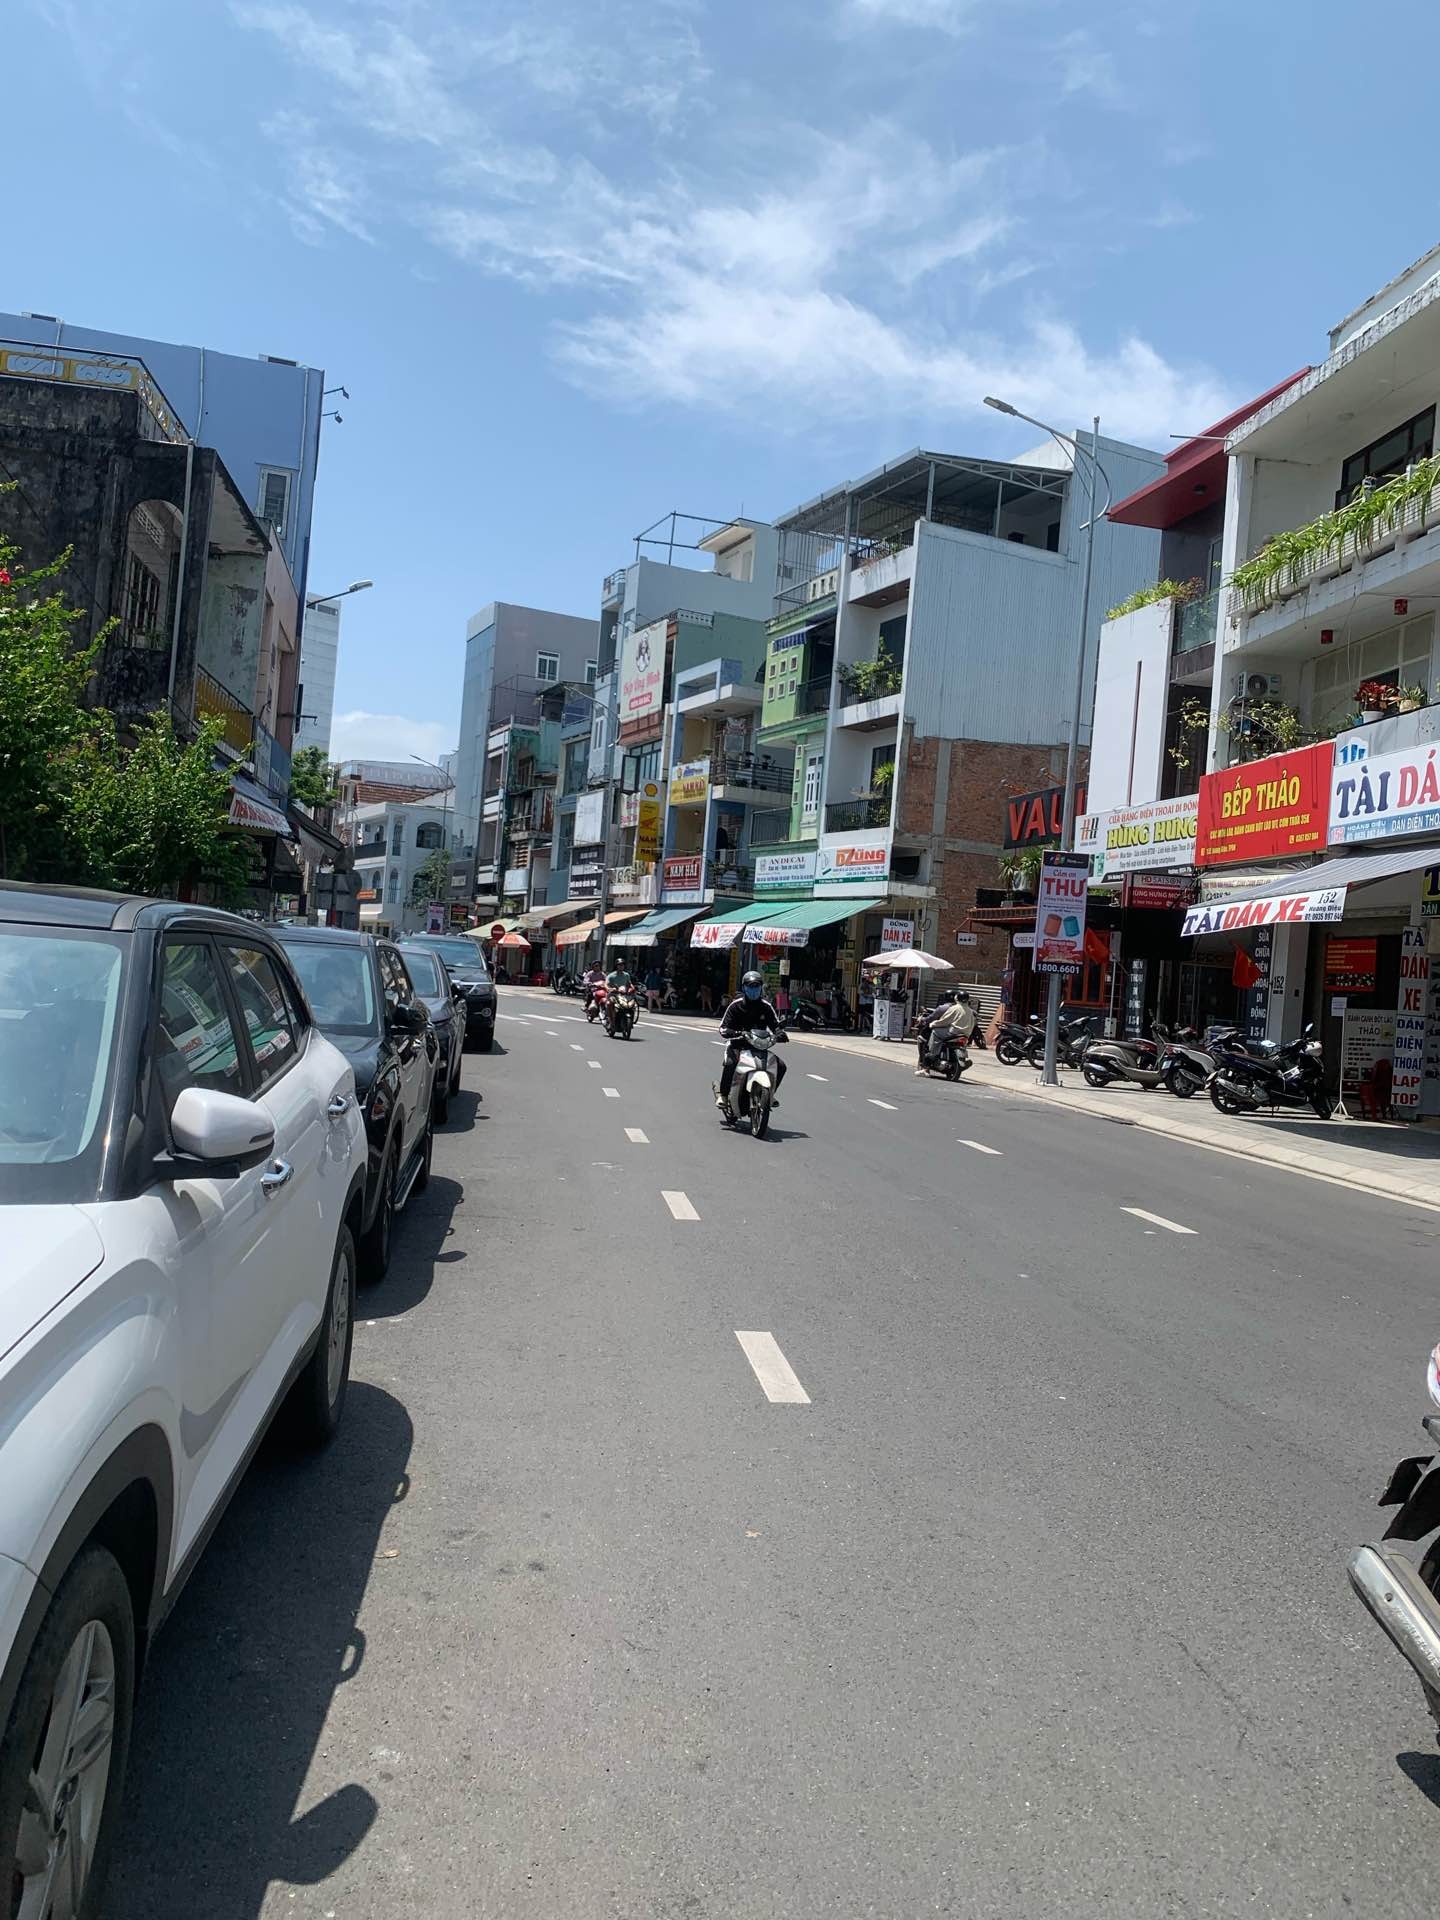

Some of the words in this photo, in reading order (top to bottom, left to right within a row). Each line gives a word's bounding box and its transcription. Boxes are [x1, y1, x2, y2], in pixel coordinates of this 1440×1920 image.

[1220, 775, 1252, 818] BẾP
[1255, 768, 1300, 812] THẢO
[1336, 765, 1391, 818] TÀI
[1106, 824, 1149, 850] HÙNG
[1153, 815, 1198, 844] HƯNG
[670, 864, 684, 877] NAM
[1318, 891, 1337, 904] 152
[1183, 906, 1225, 935] TÀI
[1222, 899, 1272, 930] DÁN
[1271, 896, 1310, 922] XE
[901, 930, 912, 943] XE
[1037, 963, 1080, 975] 1800.6601
[1399, 953, 1430, 979] DÁN
[1273, 976, 1286, 989] 152
[1256, 993, 1263, 1003] DI
[1402, 988, 1422, 1011] XE
[1250, 1005, 1266, 1020] ĐỘNG
[1397, 1018, 1424, 1030] DÁN
[1396, 1035, 1423, 1052] ĐIỆN
[1394, 1056, 1423, 1072] THOẠI
[1393, 1075, 1420, 1088] LAP
[1391, 1093, 1418, 1105] TOP
